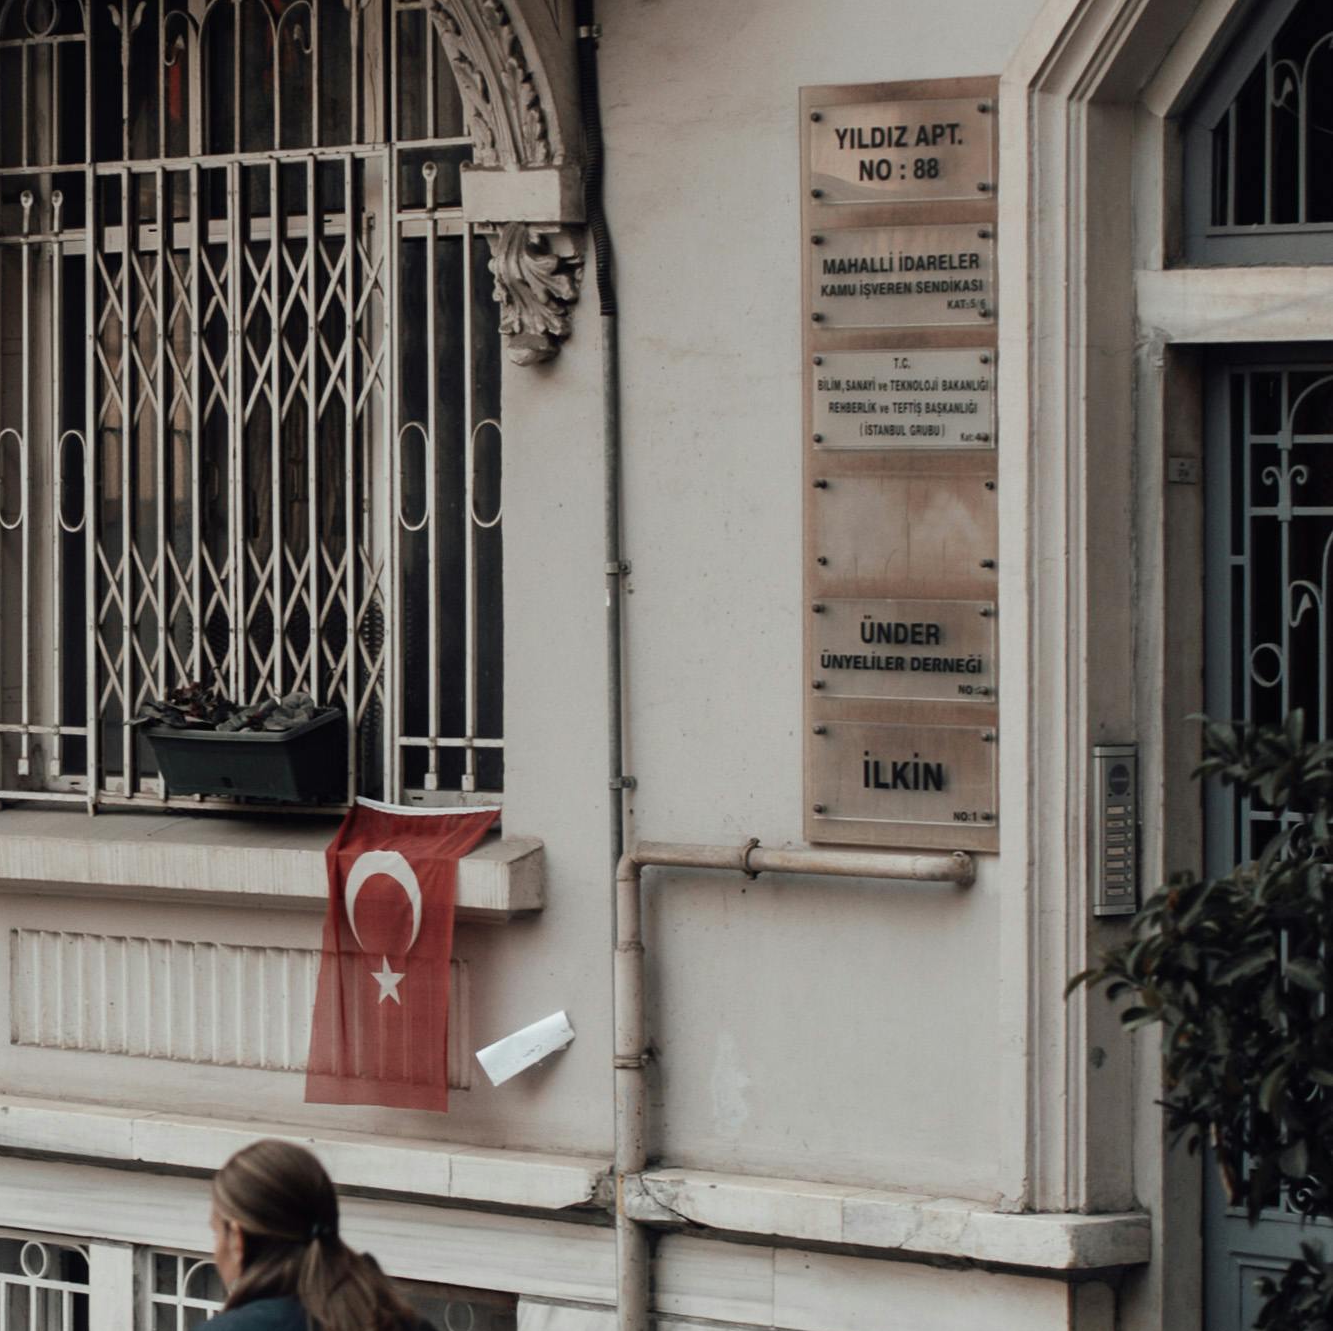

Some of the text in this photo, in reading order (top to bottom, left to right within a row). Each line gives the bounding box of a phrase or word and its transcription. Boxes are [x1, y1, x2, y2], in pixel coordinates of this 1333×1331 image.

[835, 123, 963, 150] YILDIZ APT.
[859, 159, 891, 181] NO
[913, 158, 939, 179] 88
[823, 251, 980, 275] MAHALLİ İDARELER
[821, 276, 983, 299] KAMU İŞVEREN SENDİKASI
[893, 357, 911, 369] T.C.
[877, 382, 888, 391] ve
[890, 376, 938, 391] TEKNOLOJİ
[942, 376, 989, 391] BAKANLIĞI
[829, 398, 978, 417] REHBERLİK ve TEFTİŞ BAŞKANLIĞI
[859, 421, 946, 437] (İSTANBUL GRUBU)
[860, 615, 941, 645] ÜNDER
[821, 649, 983, 674] ÜNYELİLER DERNEĞİ
[863, 750, 944, 791] İLKİN
[953, 811, 977, 822] NO:1
